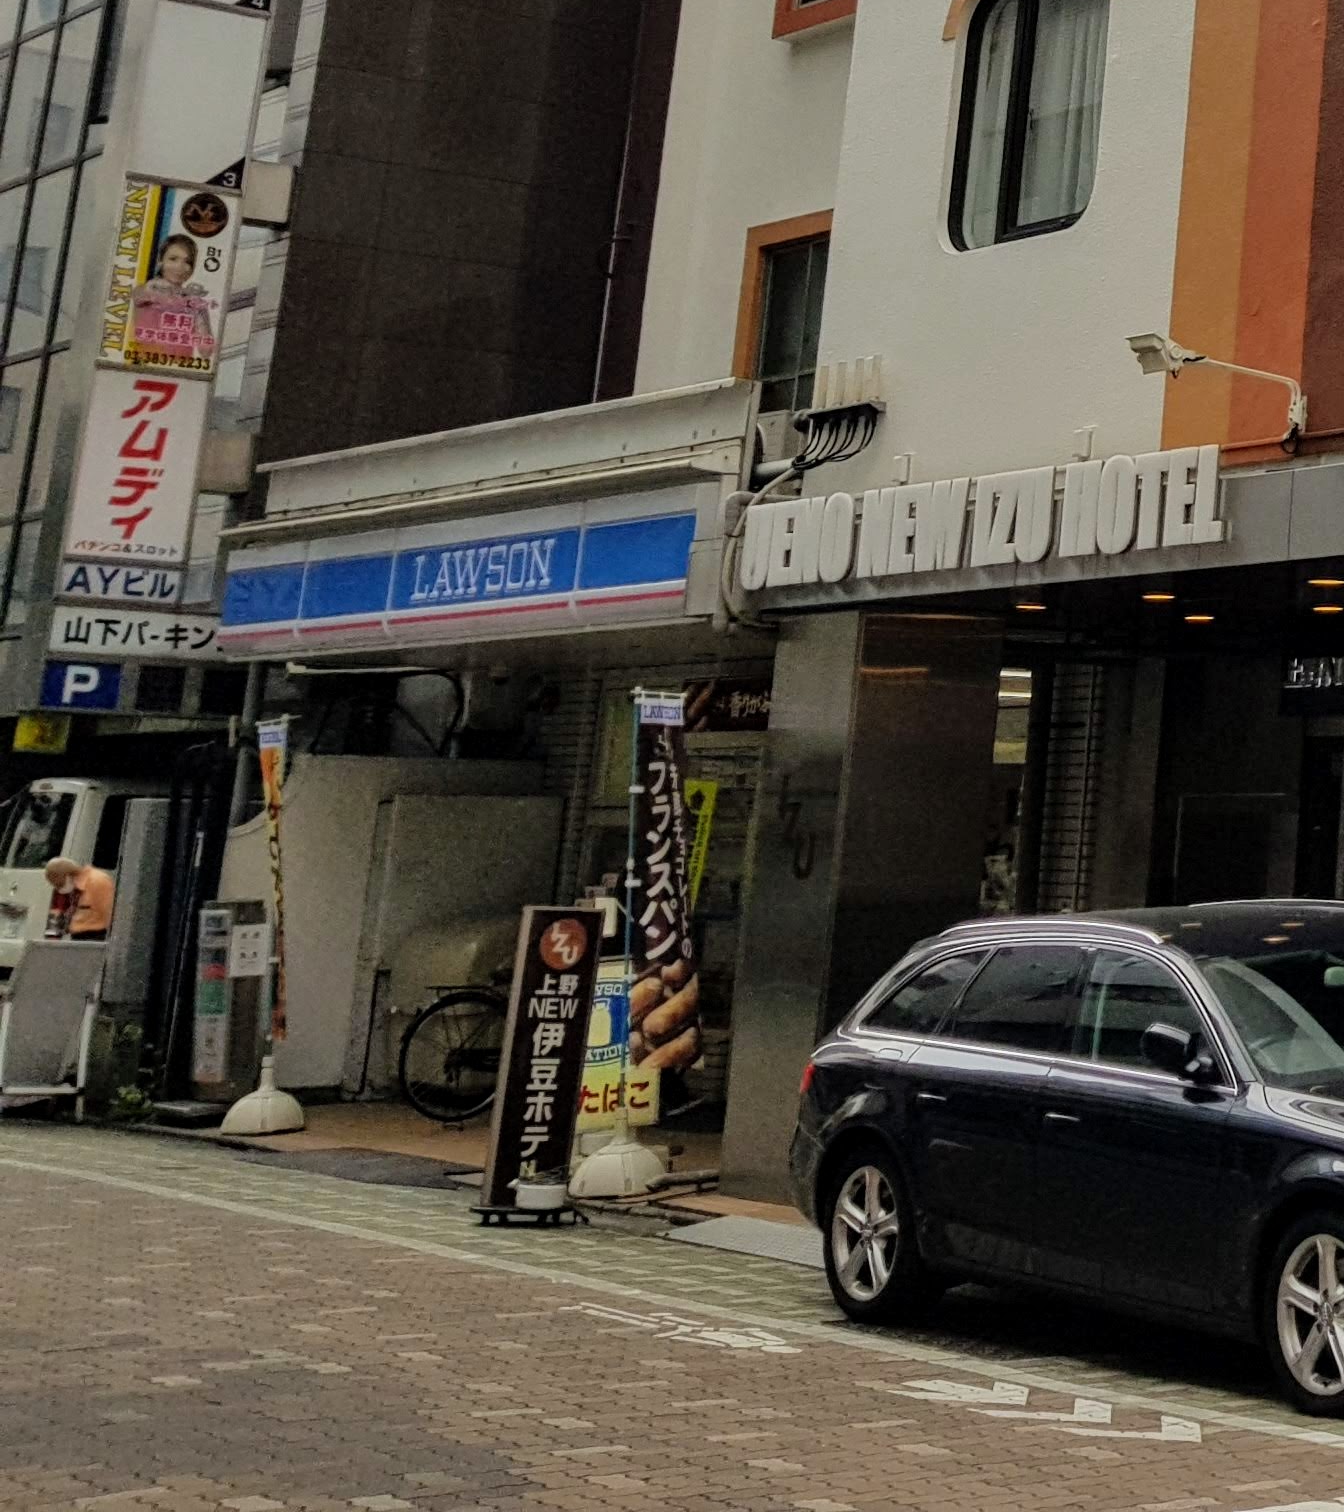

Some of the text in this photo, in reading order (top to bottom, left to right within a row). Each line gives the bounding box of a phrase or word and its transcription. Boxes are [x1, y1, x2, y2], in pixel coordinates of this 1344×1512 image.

[223, 173, 237, 187] 3
[100, 180, 150, 358] NEXT LEVEL
[108, 379, 179, 540] アムディ
[741, 444, 1225, 590] UENO NEW IZU HOTEL
[65, 565, 175, 598] AYビル
[411, 538, 555, 602] LAWSON
[64, 616, 224, 654] 山下パーキン
[61, 664, 99, 704] P
[535, 974, 579, 997] 上野
[528, 998, 579, 1019] NEW
